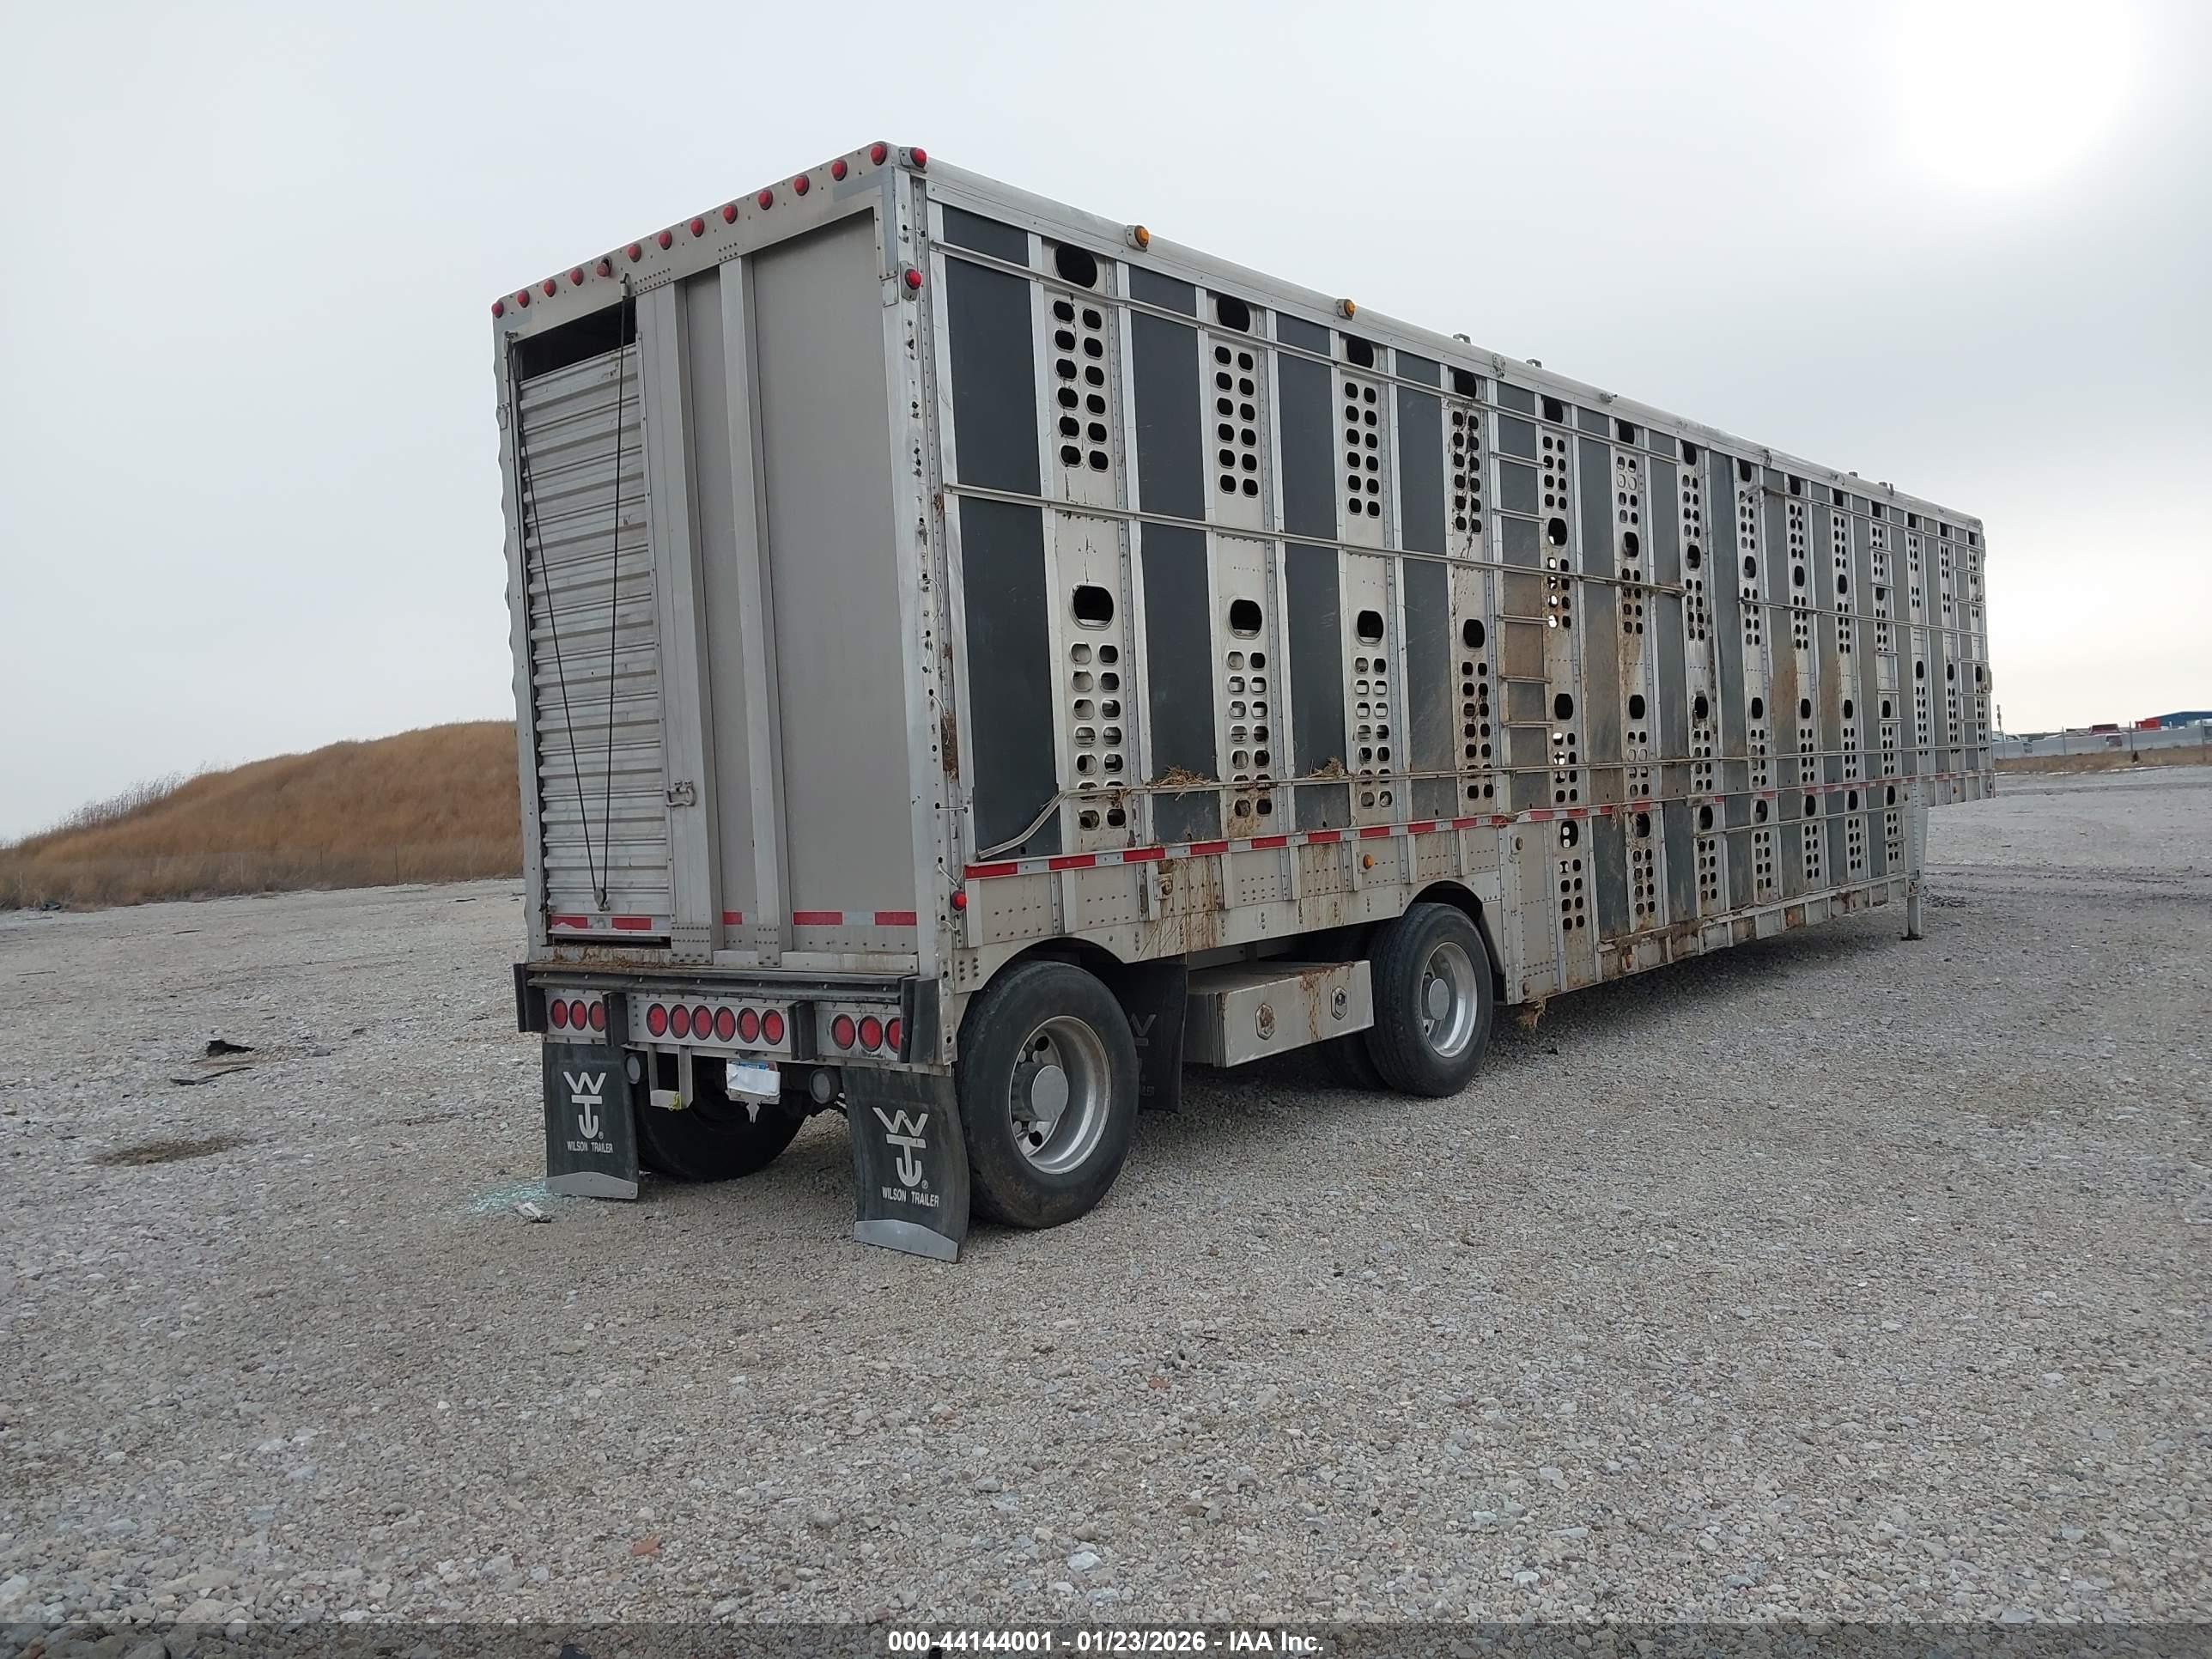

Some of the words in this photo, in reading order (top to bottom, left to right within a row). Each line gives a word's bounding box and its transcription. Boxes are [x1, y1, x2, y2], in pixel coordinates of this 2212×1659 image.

[567, 1140, 588, 1152] WILSON
[591, 1141, 613, 1153] TRAILER
[882, 1186, 907, 1203] WILSON
[911, 1190, 939, 1208] TRAILER
